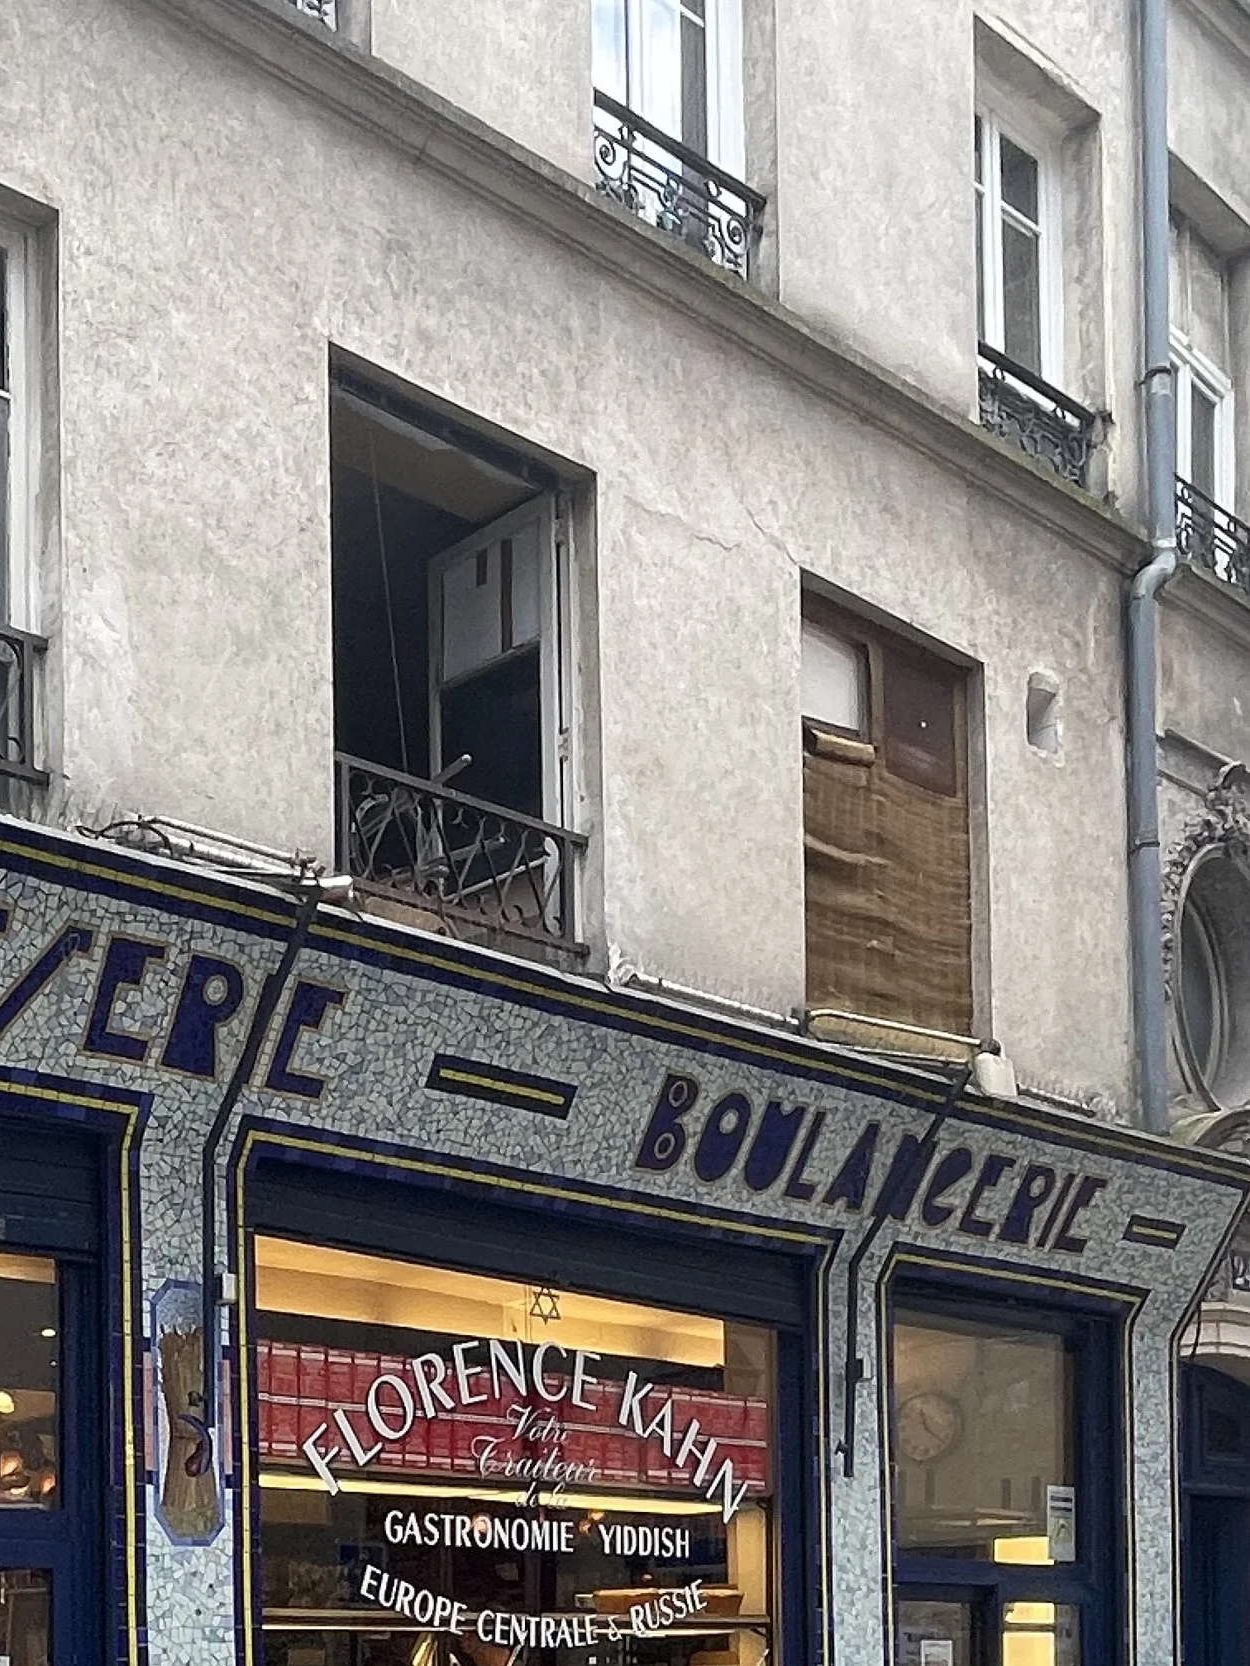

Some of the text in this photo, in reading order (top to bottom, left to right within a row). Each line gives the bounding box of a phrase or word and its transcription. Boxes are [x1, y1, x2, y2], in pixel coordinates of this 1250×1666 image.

[633, 1071, 1107, 1253] BOULANGERIE
[301, 1339, 754, 1524] FLORENCE KAHN
[507, 1403, 570, 1445] Votre
[471, 1436, 600, 1480] Traiteur
[385, 1510, 690, 1558] GASTRONOMIE YIDDISH
[360, 1565, 707, 1648] EUROPE CENTRALE & RUSSIE
